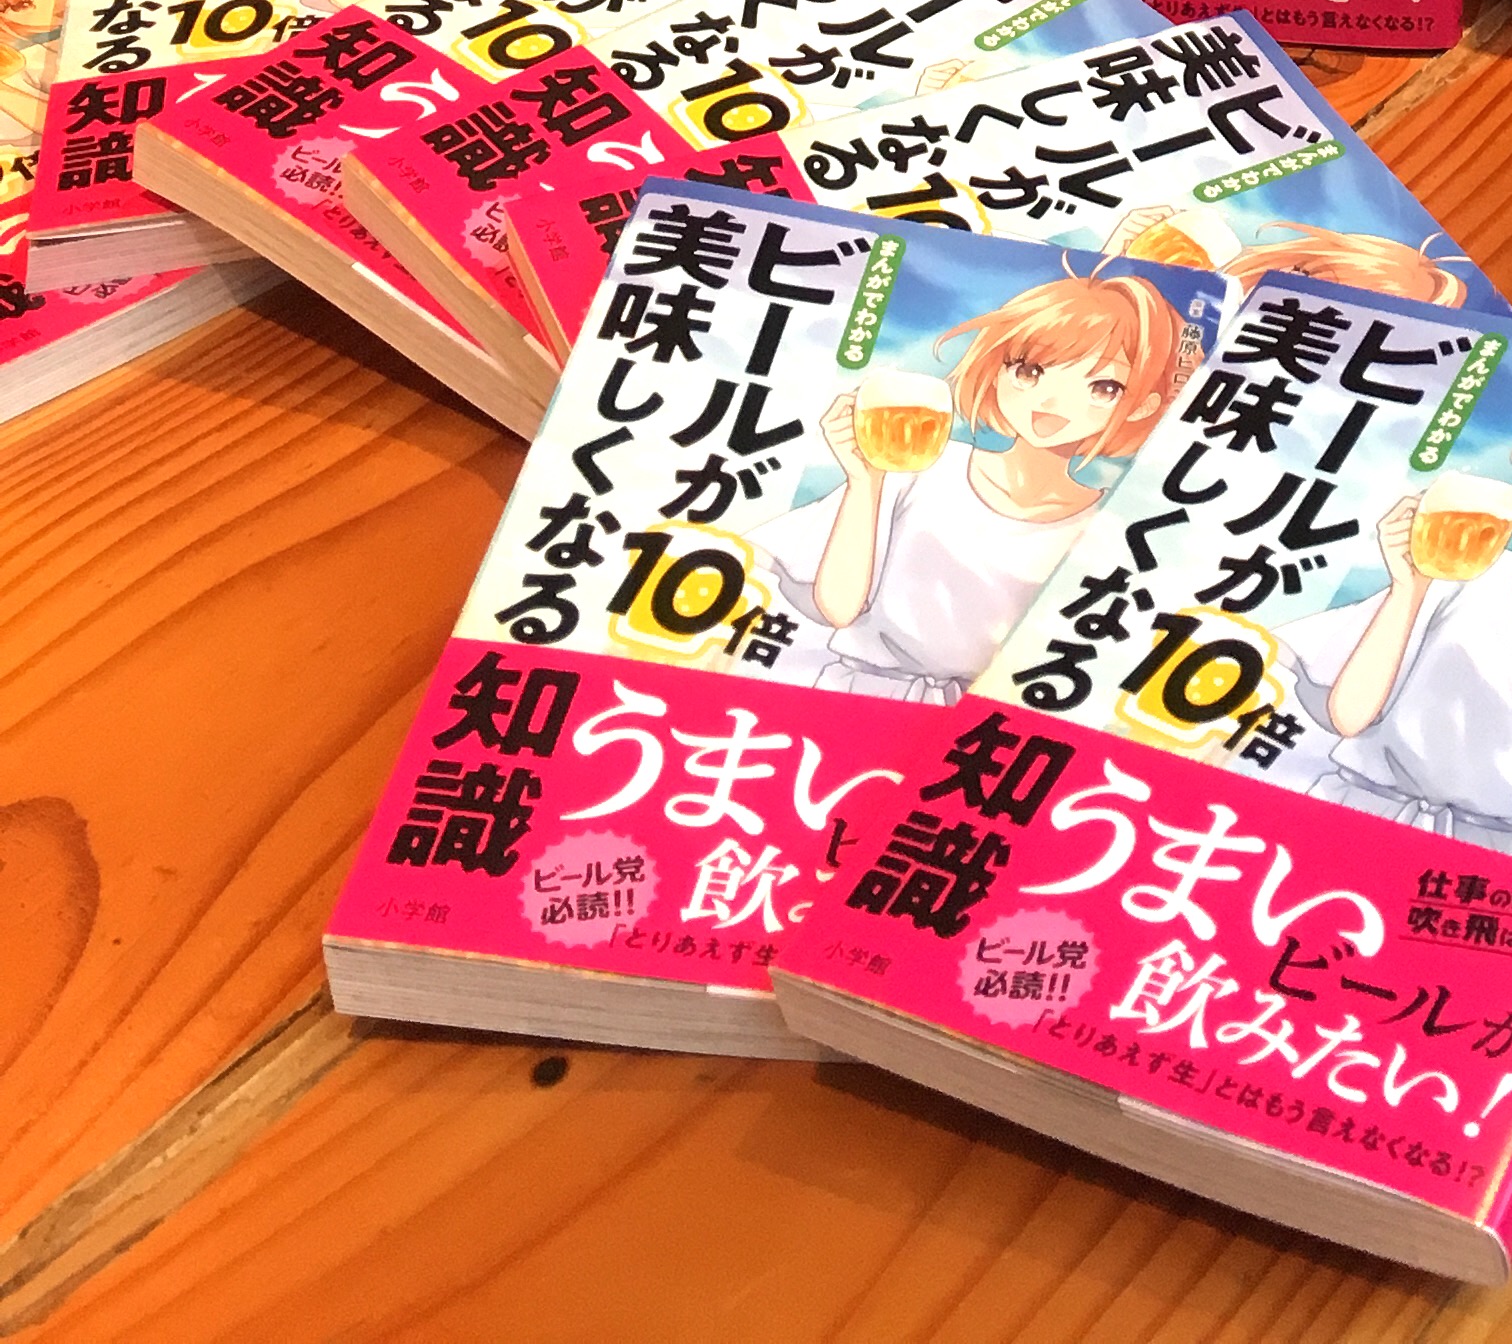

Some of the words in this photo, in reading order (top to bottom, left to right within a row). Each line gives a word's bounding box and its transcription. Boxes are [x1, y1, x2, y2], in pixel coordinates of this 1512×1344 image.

[844, 238, 900, 363] まんがでわかる
[607, 221, 875, 669] ビールが10倍
[1414, 334, 1504, 468] まんがでわかる
[386, 203, 743, 876] 美味しくなる知識
[1119, 317, 1472, 775] ビールが10倍
[846, 297, 1348, 939] 美味しくなる知識
[376, 897, 452, 926] 小学館
[532, 856, 647, 892] ビール党
[540, 890, 637, 929] 必読!!
[1022, 763, 1388, 957] うまい
[826, 940, 890, 975] 小学館
[972, 967, 1072, 1004] 必読!!
[974, 935, 1089, 974] ビール党
